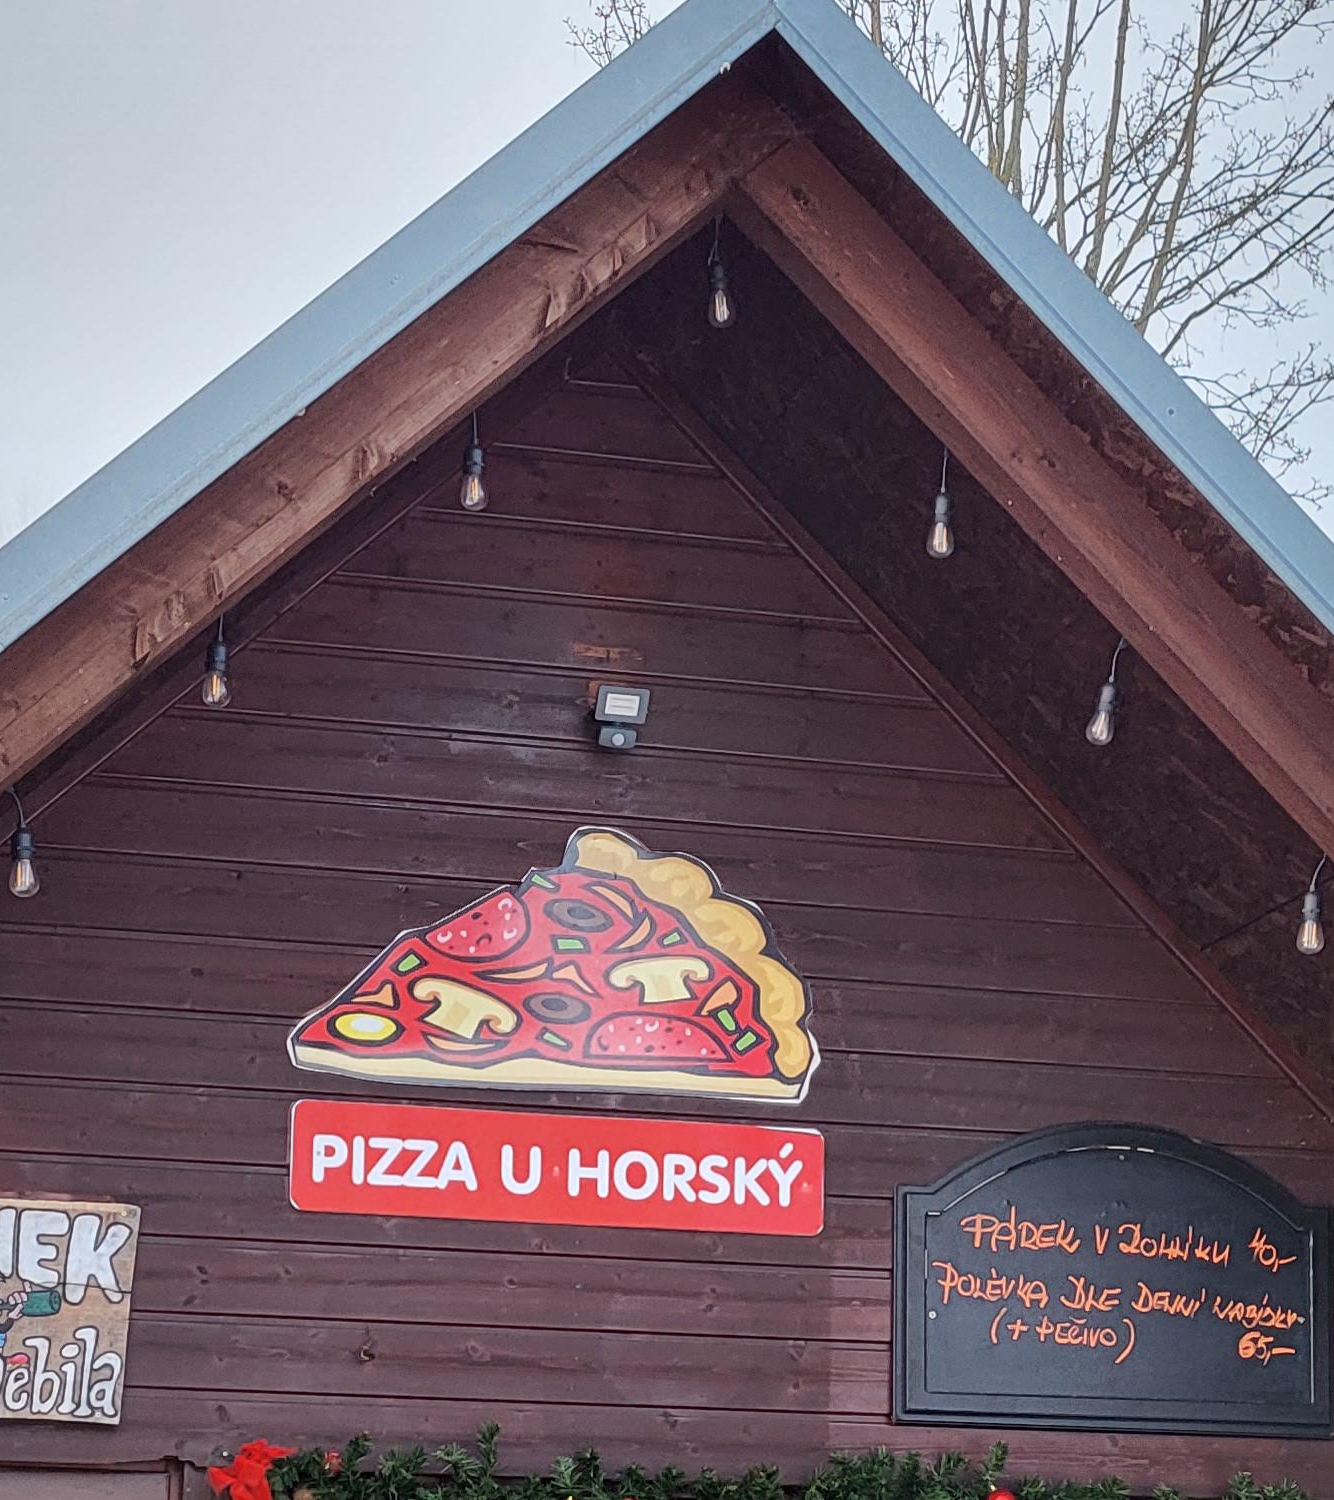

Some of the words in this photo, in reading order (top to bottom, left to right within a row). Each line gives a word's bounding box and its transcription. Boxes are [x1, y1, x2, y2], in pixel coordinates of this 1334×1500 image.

[312, 1133, 478, 1191] PIZZA
[500, 1144, 542, 1195] U
[568, 1142, 803, 1208] HORSKÝ
[1060, 1276, 1122, 1311] DLE
